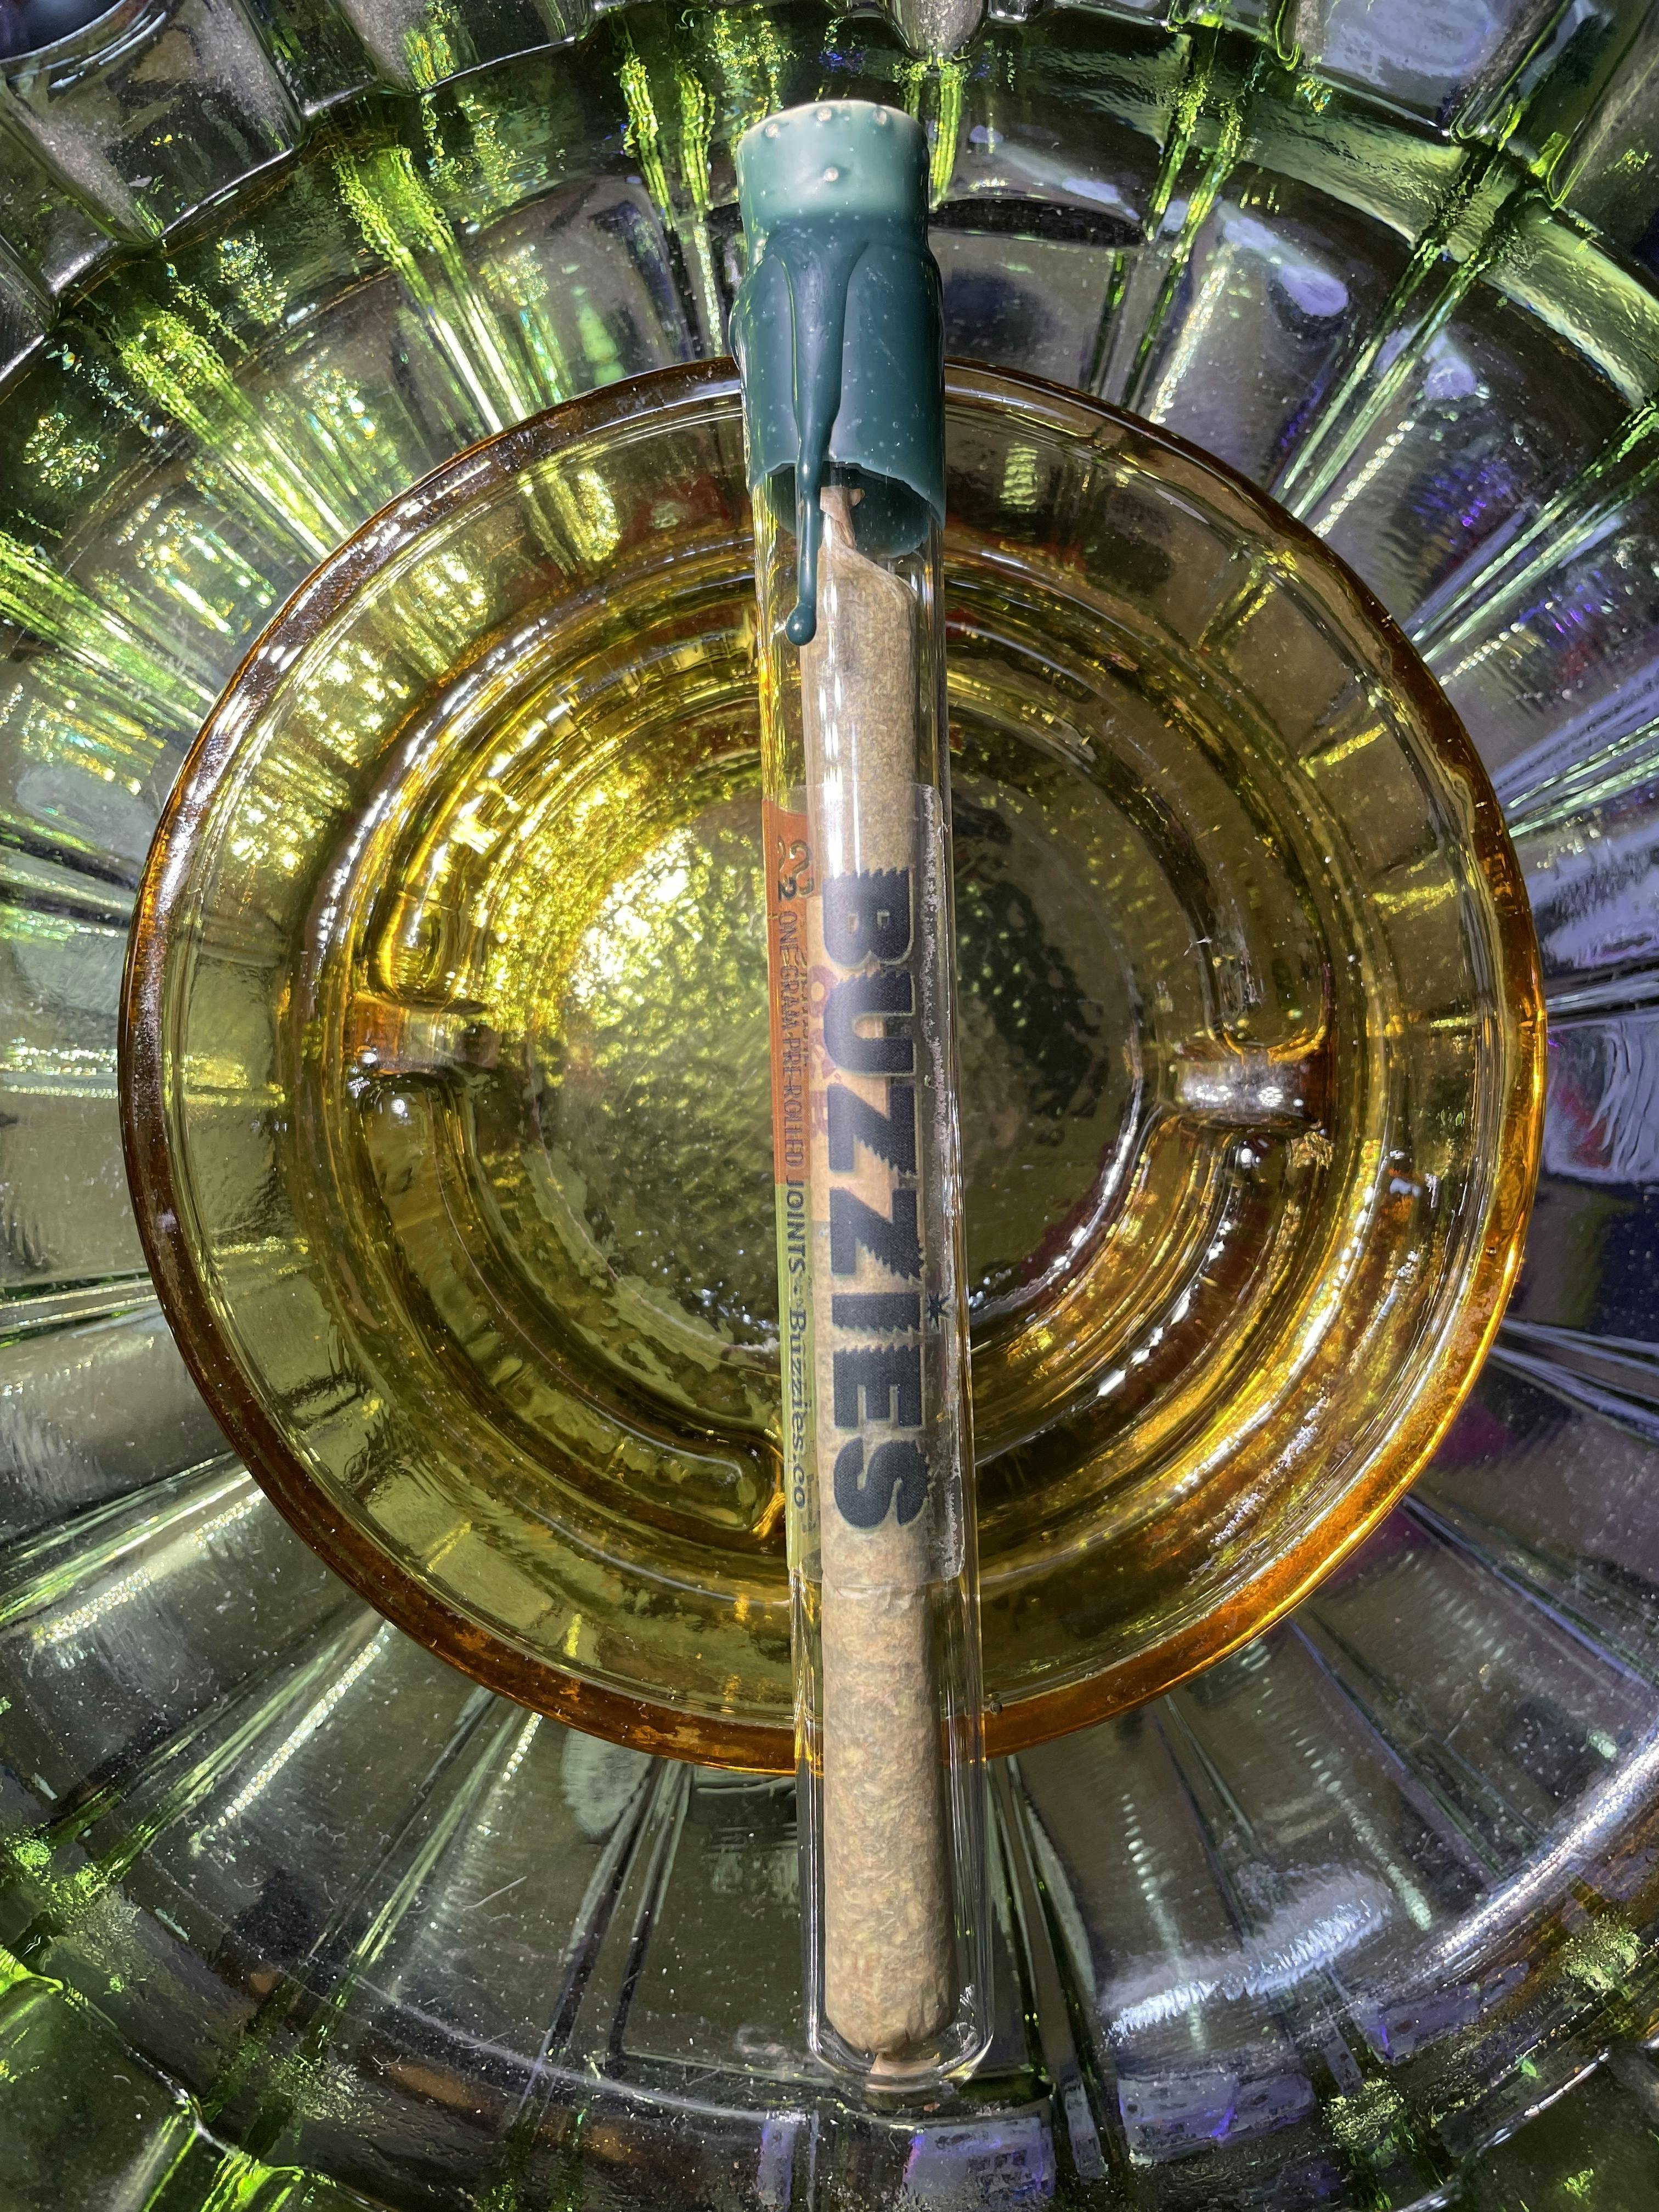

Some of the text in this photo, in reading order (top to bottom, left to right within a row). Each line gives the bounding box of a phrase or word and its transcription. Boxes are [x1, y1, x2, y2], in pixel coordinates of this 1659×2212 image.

[782, 1037, 804, 1167] PRE-ROLLED
[785, 1176, 806, 1275] JOINTS
[822, 867, 931, 1529] BUZZIES
[789, 1309, 810, 1509] Buzzies.co
